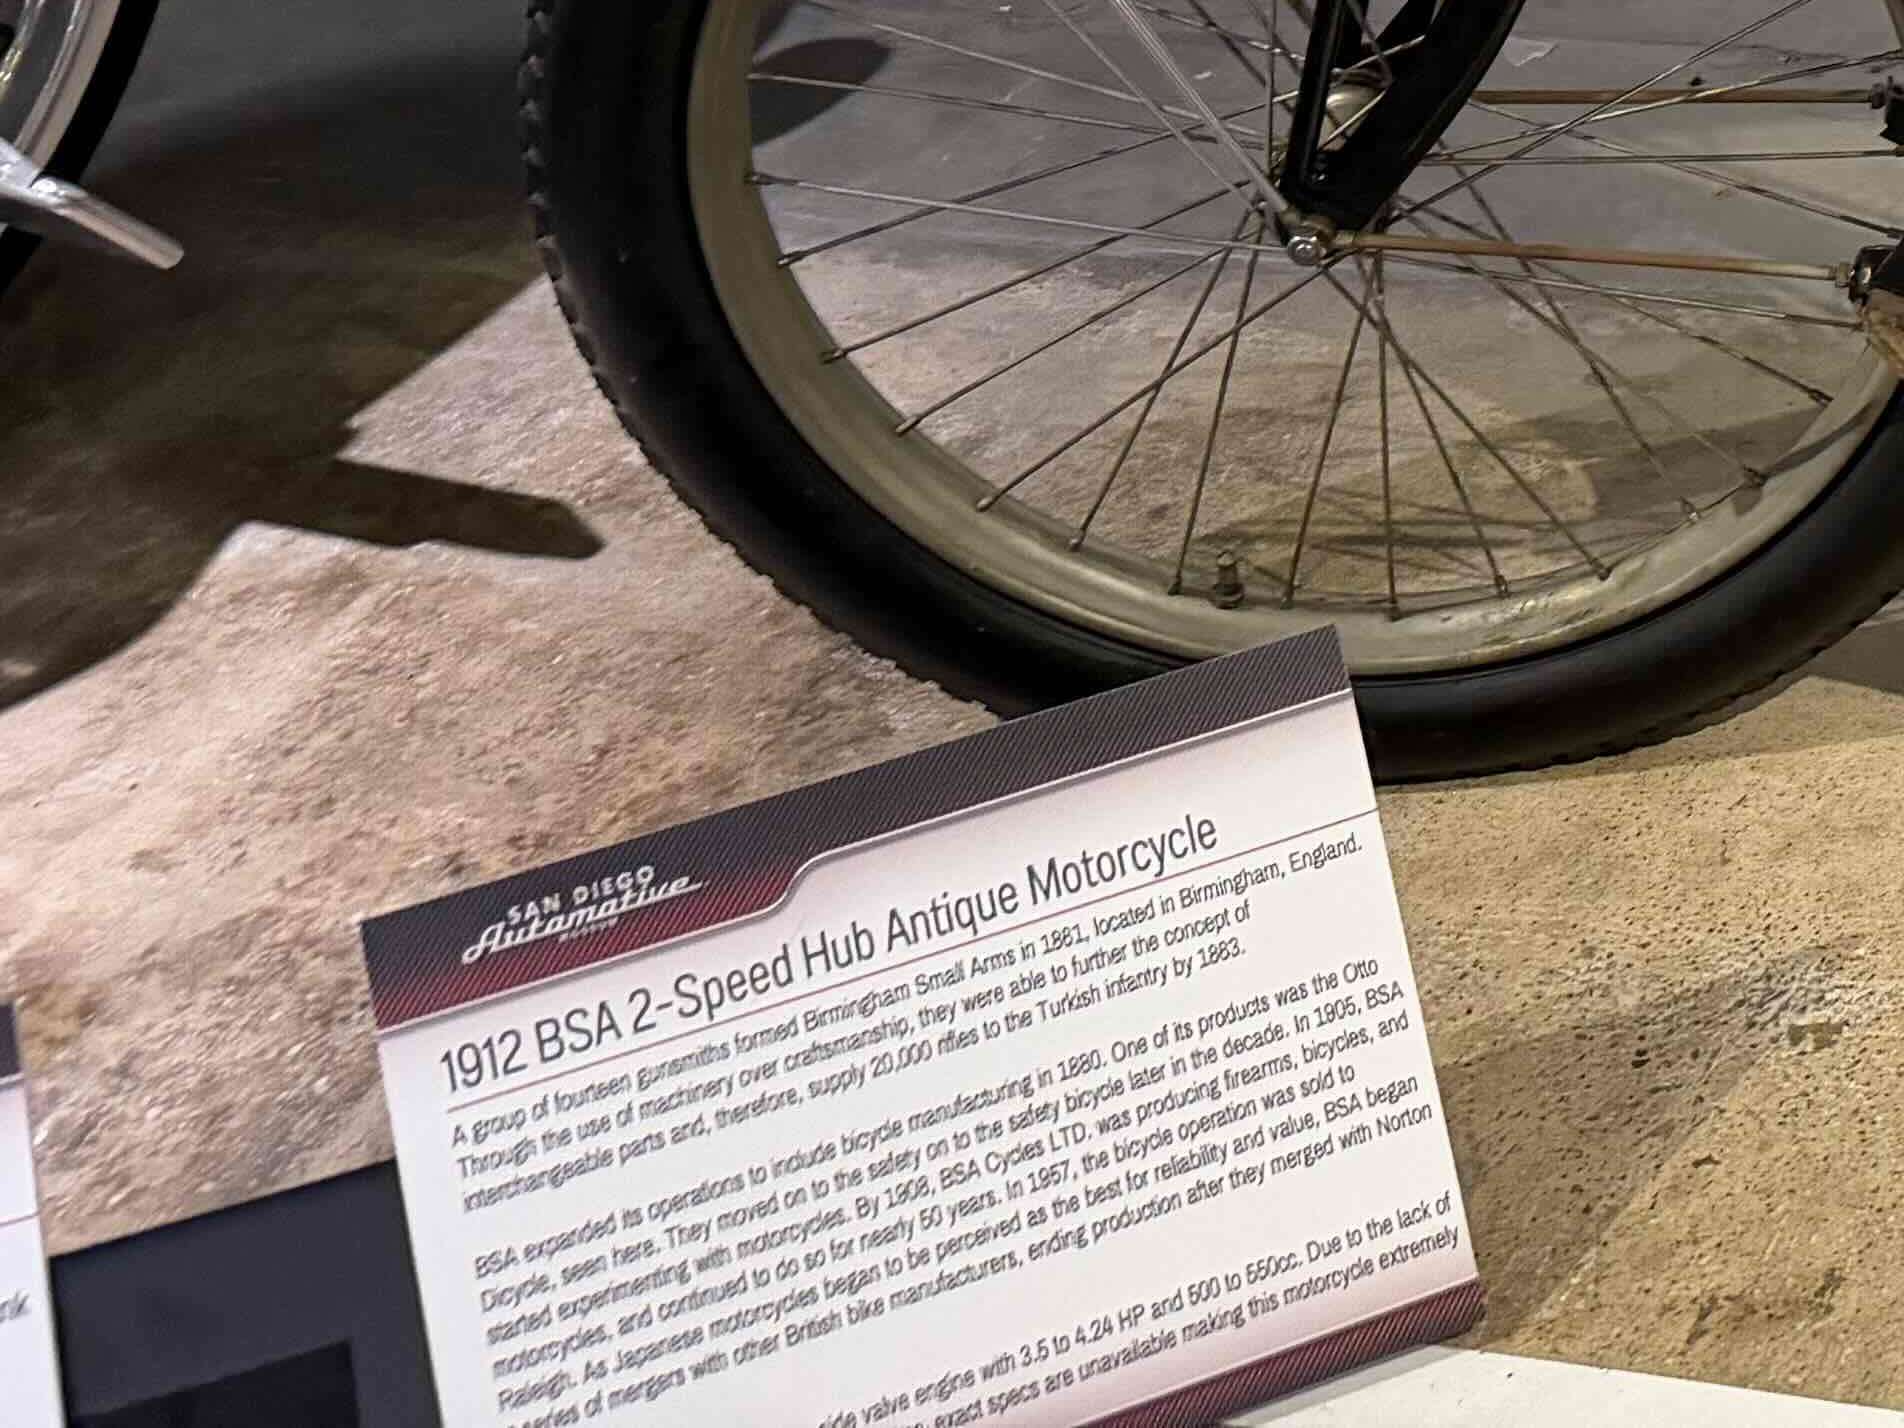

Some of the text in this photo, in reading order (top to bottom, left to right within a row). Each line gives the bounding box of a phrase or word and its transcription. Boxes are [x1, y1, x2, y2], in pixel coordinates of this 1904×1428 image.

[440, 814, 1217, 1093] 1912 BSA 2-Speed Hub Antique Motorcycle
[461, 875, 703, 965] Automotive
[508, 864, 656, 925] SAN DIEGO
[783, 1015, 915, 1073] craftsmanship,
[917, 1001, 957, 1029] they
[960, 986, 1005, 1013] were
[1009, 970, 1047, 999] able
[1050, 965, 1068, 984] to
[1071, 944, 1127, 978] further
[1131, 934, 1160, 957] the
[1164, 908, 1231, 947] concept
[1234, 898, 1250, 923] of
[802, 983, 911, 1033] Birmingham
[914, 959, 966, 996] Small
[970, 949, 1017, 979] Arms
[1019, 941, 1036, 961] in
[1093, 898, 1156, 937] located
[1159, 895, 1176, 916] in
[1179, 862, 1285, 909] Birmingham,
[1288, 831, 1362, 873] England.
[807, 1063, 866, 1099] supply
[869, 1039, 933, 1079] 20,000
[937, 1028, 980, 1056] rifles
[982, 1020, 1001, 1040] to
[1004, 1010, 1033, 1033] the
[1035, 983, 1101, 1021] Turkish
[1104, 964, 1168, 999] infantry
[1172, 955, 1193, 979] by
[833, 1167, 864, 1193] the
[867, 1147, 921, 1182] safety
[926, 1138, 950, 1162] on
[952, 1131, 971, 1152] to
[974, 1120, 1004, 1144] the
[1008, 1100, 1060, 1133] safety
[1064, 1077, 1125, 1113] bicycle
[1128, 1064, 1166, 1091] later
[1169, 1056, 1187, 1077] in
[1190, 1046, 1218, 1070] the
[1222, 1022, 1290, 1059] decade.
[1293, 1015, 1310, 1034] In
[1364, 980, 1404, 1010] BSA
[841, 1119, 904, 1156] bicycle
[907, 1073, 1035, 1133] manufacturing
[1036, 1068, 1054, 1089] in
[1111, 1036, 1149, 1063] One
[1153, 1023, 1169, 1049] of
[1172, 1022, 1194, 1043] its
[1198, 995, 1270, 1039] products
[1274, 982, 1309, 1007] was
[1311, 972, 1339, 995] the
[1342, 959, 1378, 984] Otto
[855, 1195, 880, 1221] By
[939, 1158, 982, 1192] BSA
[984, 1139, 1045, 1176] Cycles
[1095, 1109, 1132, 1136] was
[1136, 1075, 1222, 1127] producing
[1223, 1053, 1298, 1092] firearms,
[1301, 1027, 1374, 1064] bicycles,
[1377, 1009, 1409, 1038] and
[846, 1296, 885, 1325] bike
[889, 1250, 1023, 1310] manufacturers,
[1028, 1224, 1089, 1261] ending
[1091, 1192, 1182, 1244] production
[1186, 1176, 1224, 1205] after
[1228, 1162, 1265, 1190] they
[1270, 1133, 1334, 1175] merged
[1338, 1123, 1373, 1150] with
[1376, 1104, 1432, 1137] Norton
[859, 1216, 915, 1253] nearly
[946, 1189, 1002, 1228] years.
[1005, 1179, 1024, 1201] In
[1081, 1150, 1110, 1175] the
[1113, 1127, 1174, 1164] bicycle
[1178, 1099, 1257, 1142] operation
[1260, 1085, 1296, 1111] was
[1300, 1067, 1335, 1098] sold
[1338, 1065, 1355, 1085] to
[884, 1256, 903, 1279] to
[906, 1247, 931, 1271] be
[935, 1210, 1022, 1265] perceived
[1026, 1206, 1048, 1229] as
[1051, 1195, 1081, 1219] the
[1084, 1176, 1123, 1208] best
[1125, 1170, 1149, 1194] for
[1154, 1142, 1227, 1183] reliability
[1232, 1125, 1265, 1156] and
[1268, 1112, 1320, 1142] value,
[1323, 1093, 1363, 1123] BSA
[1365, 1076, 1418, 1108] began
[861, 1392, 910, 1423] valve
[914, 1369, 976, 1406] engine
[979, 1352, 1017, 1383] with
[1052, 1335, 1071, 1356] to
[1075, 1315, 1114, 1345] 4.24
[1118, 1304, 1145, 1333] HP
[1151, 1288, 1184, 1321] and
[1224, 1273, 1242, 1293] to
[1306, 1236, 1343, 1264] Due
[1345, 1228, 1363, 1249] to
[1366, 1217, 1394, 1241] the
[1396, 1200, 1432, 1229] lack
[1435, 1190, 1451, 1216] of
[932, 1225, 1458, 1428] exact specs are unavailable making this motorcycle extremely
